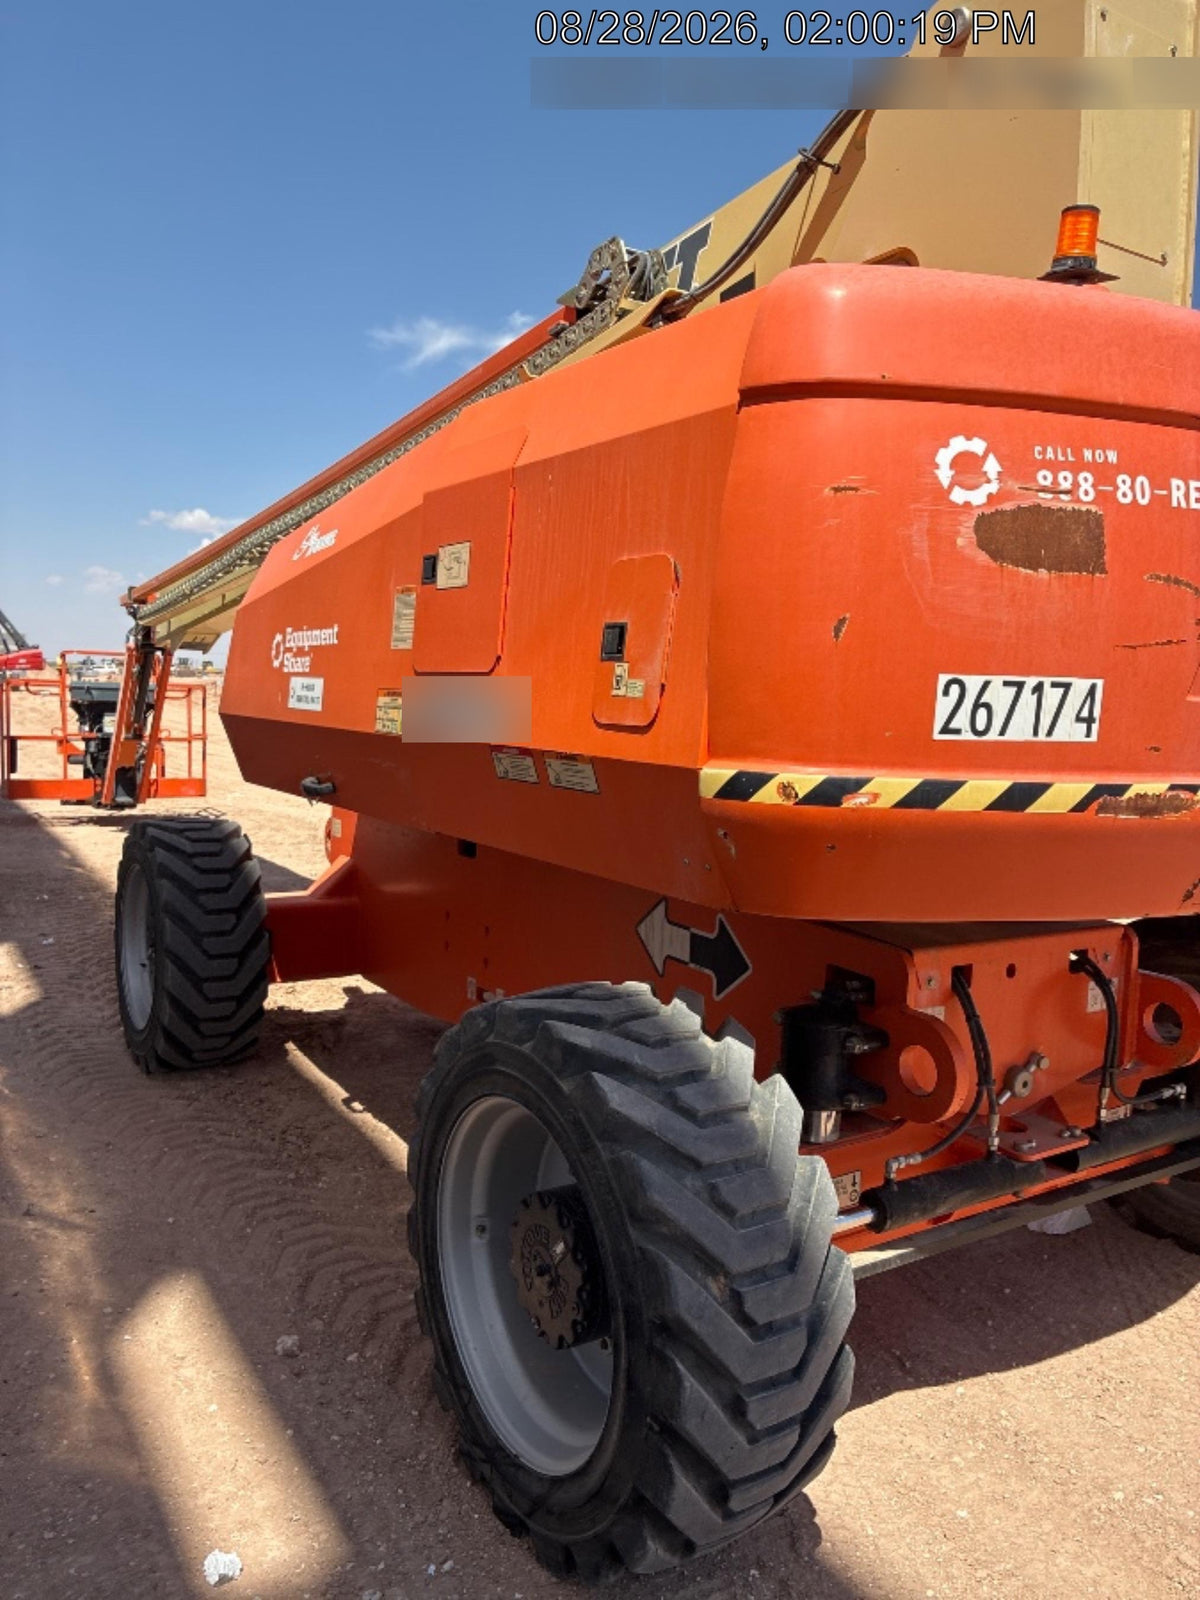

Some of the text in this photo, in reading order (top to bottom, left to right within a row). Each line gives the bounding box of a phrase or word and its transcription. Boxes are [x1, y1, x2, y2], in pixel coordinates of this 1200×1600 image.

[1034, 445, 1118, 464] CALL NOW
[285, 623, 338, 652] Equipment
[938, 677, 1098, 738] 267174
